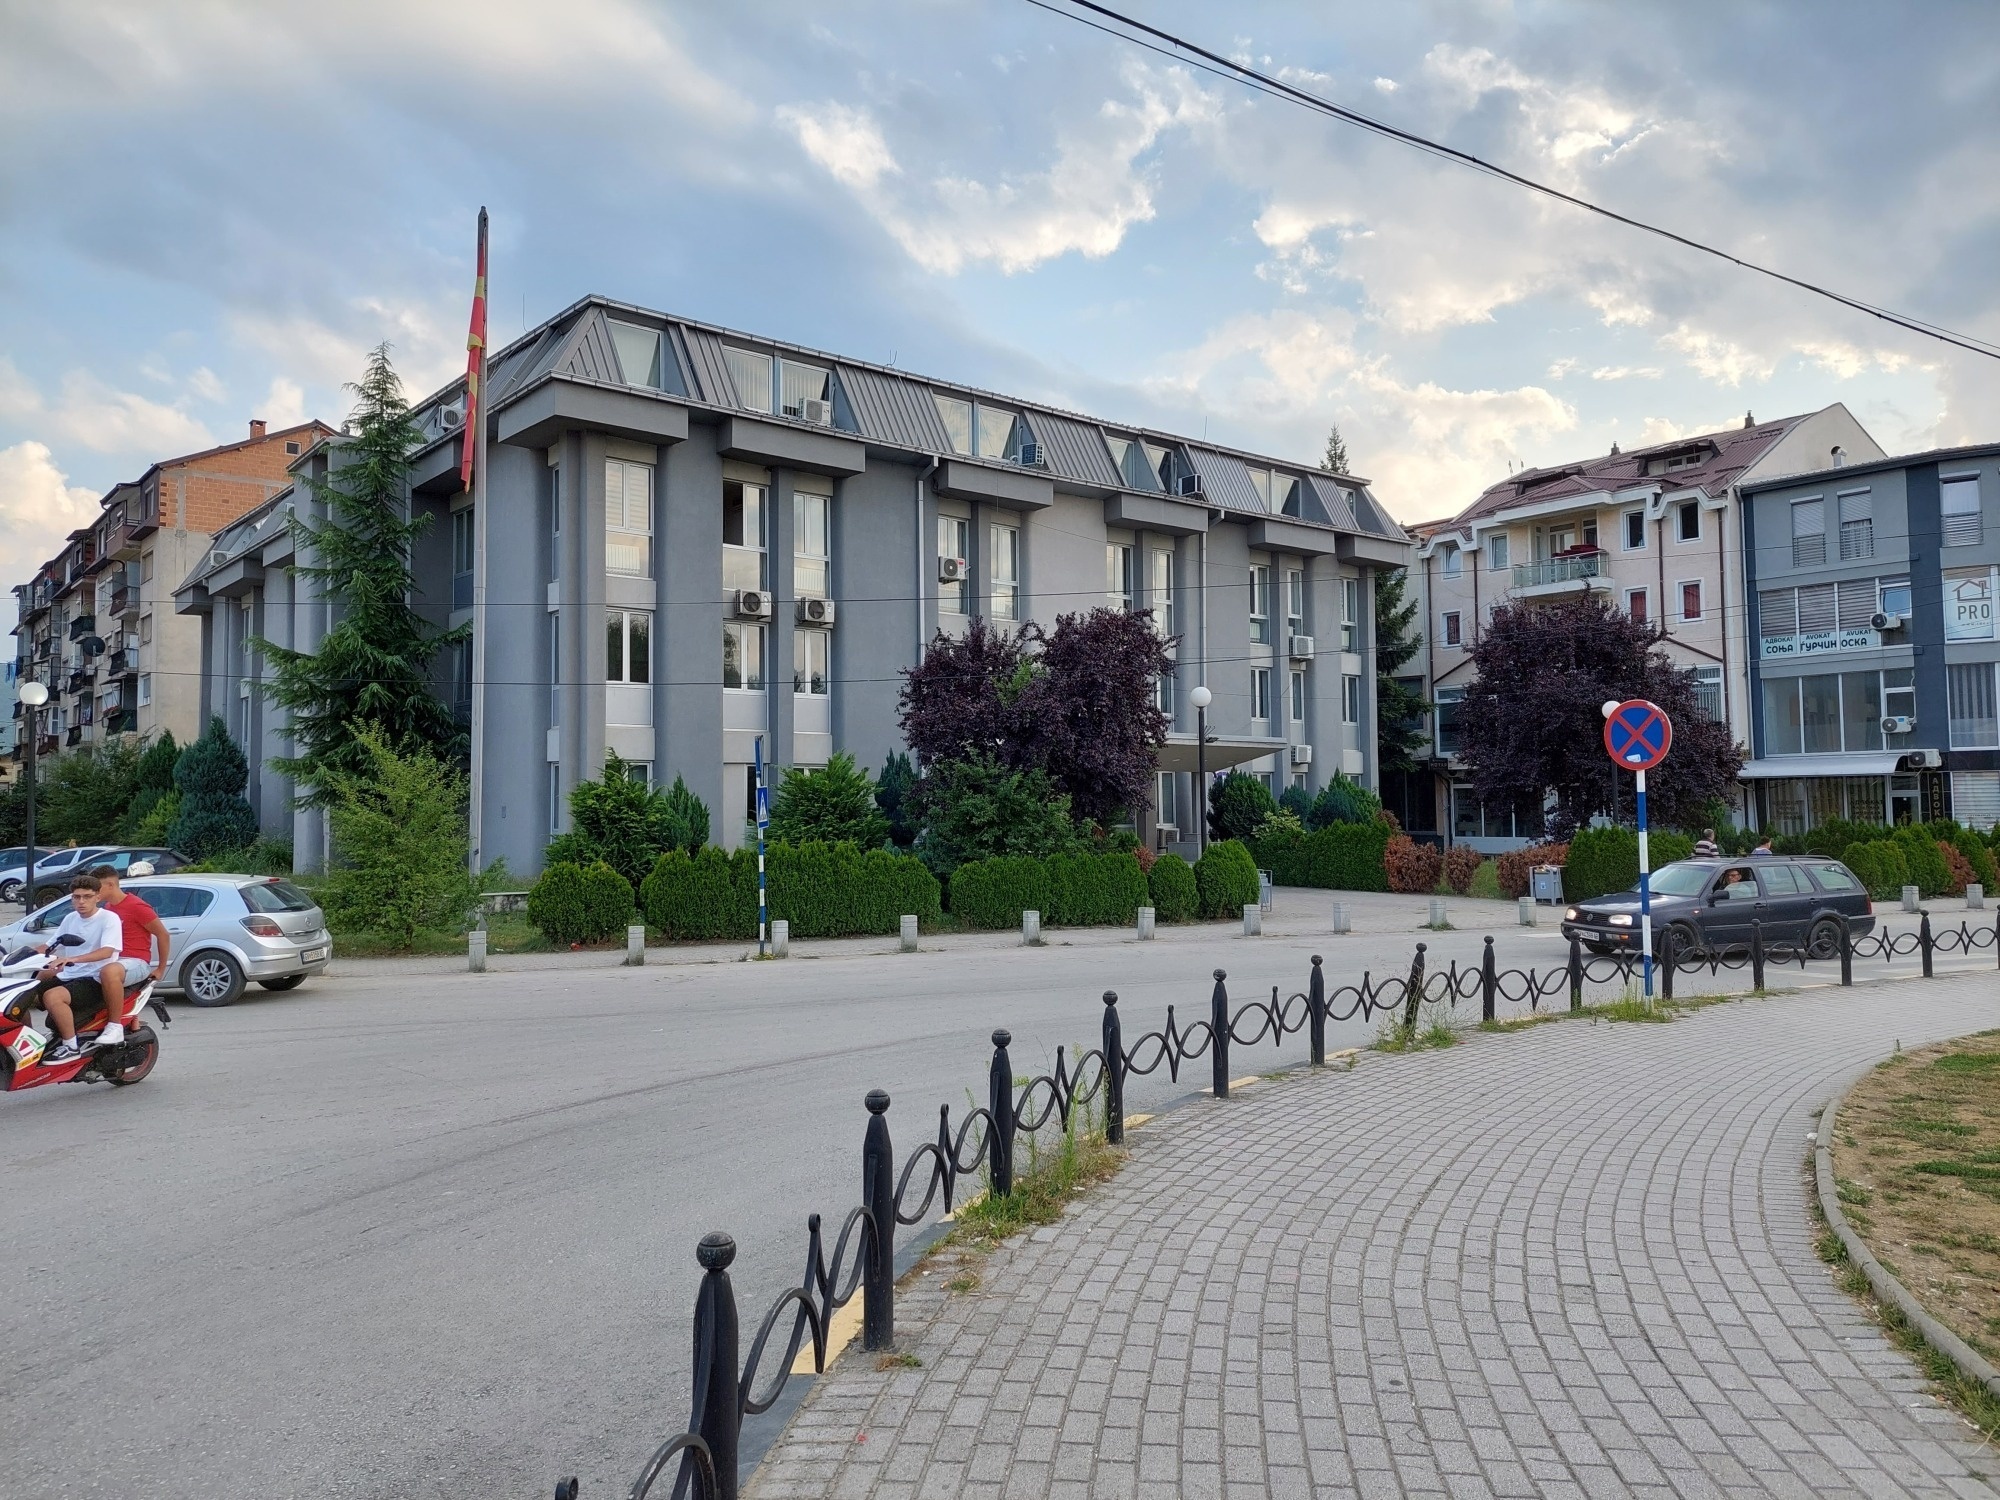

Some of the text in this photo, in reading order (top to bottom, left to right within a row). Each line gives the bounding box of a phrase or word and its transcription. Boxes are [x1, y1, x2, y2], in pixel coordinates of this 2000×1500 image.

[1957, 603, 1990, 620] PRO
[1806, 632, 1830, 640] AVOKAT
[1846, 629, 1871, 637] AVUKAT
[1765, 636, 1793, 644] АДВОКАТ
[1766, 644, 1793, 654] СОЊА
